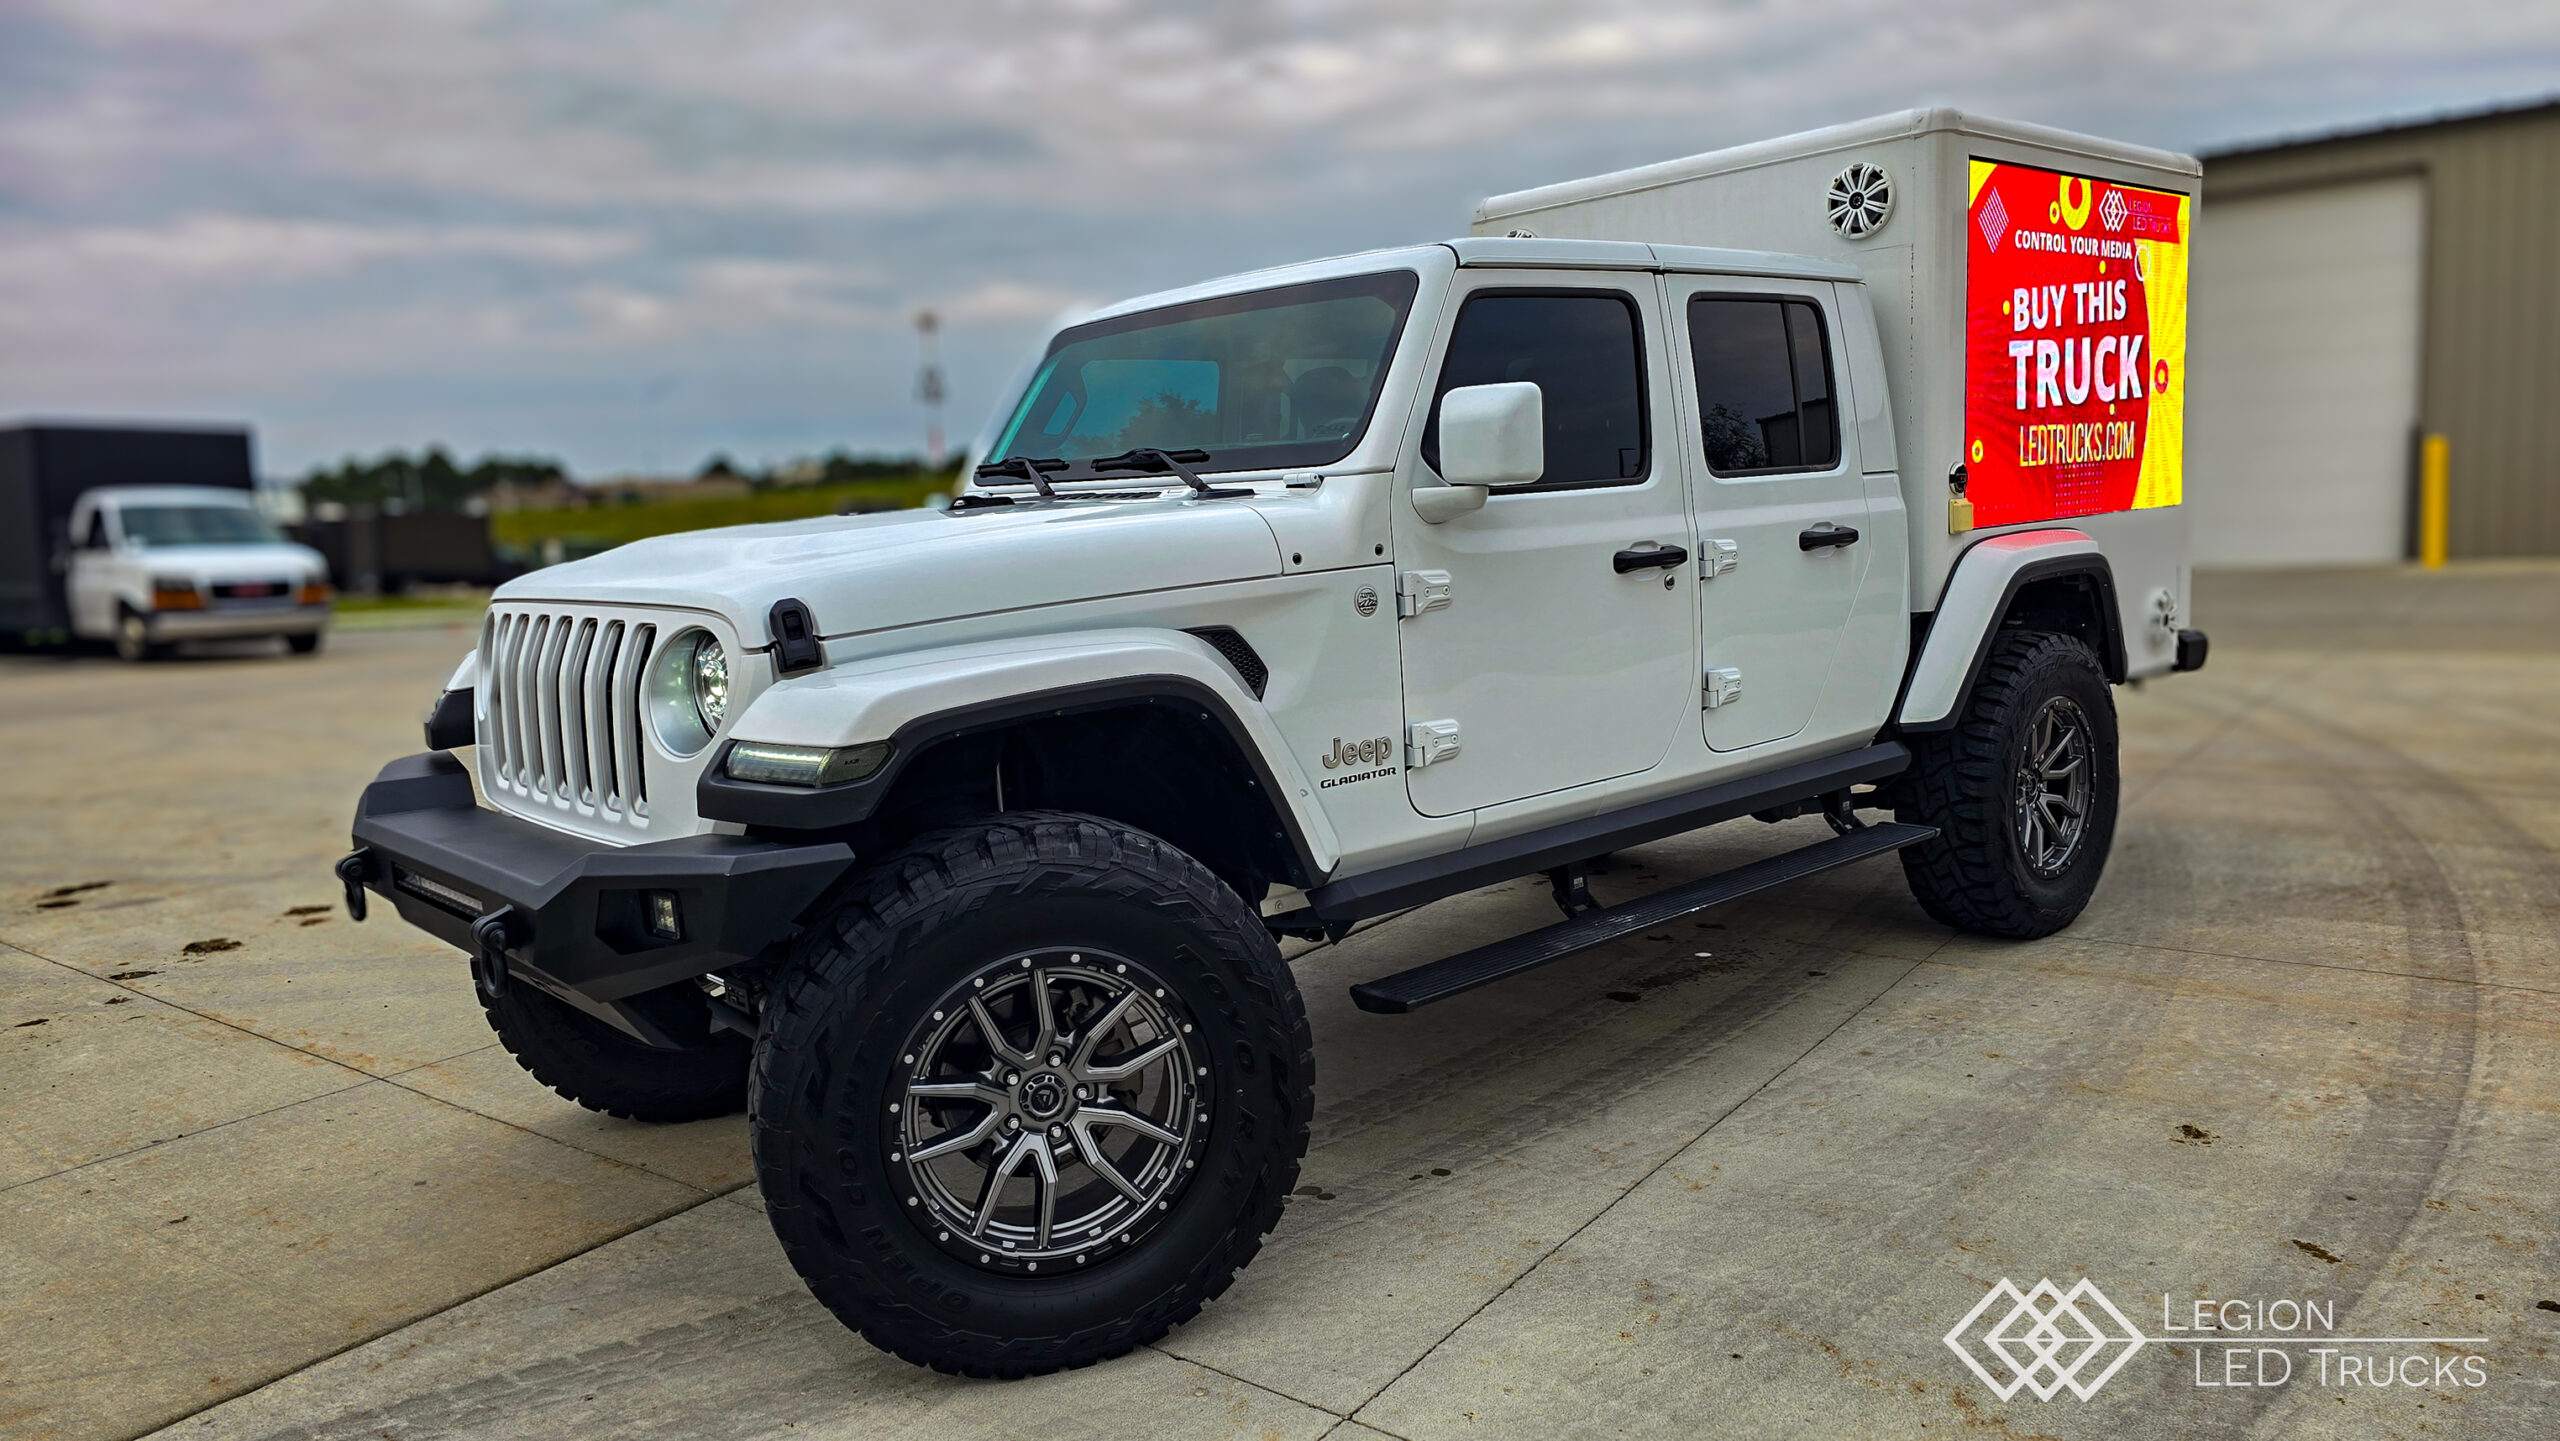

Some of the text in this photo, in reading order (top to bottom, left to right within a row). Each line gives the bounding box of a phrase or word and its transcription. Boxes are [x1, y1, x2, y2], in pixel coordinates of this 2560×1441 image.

[2129, 197, 2153, 214] LEGON
[2133, 216, 2148, 231] LED
[2014, 229, 2133, 260] CONTROL YOUR MEDIA
[2013, 279, 2127, 332] BUY THIS
[2008, 335, 2144, 410] TRUCK
[2019, 421, 2135, 467] LEDTRUCKS.COM
[1322, 736, 1393, 769] Jeep
[1320, 767, 1397, 789] GLADIATOR
[860, 1226, 972, 1312] OPEN
